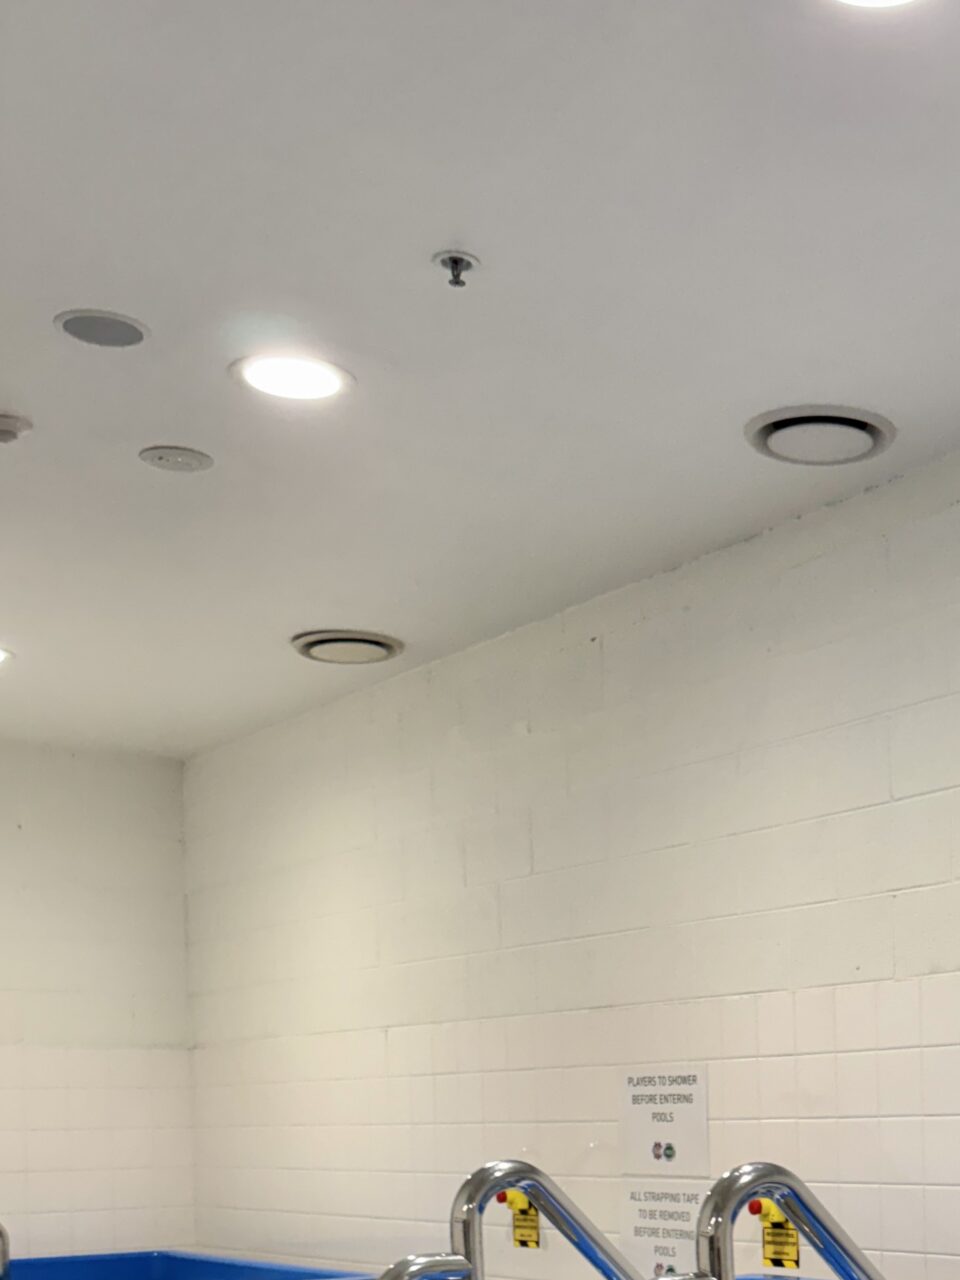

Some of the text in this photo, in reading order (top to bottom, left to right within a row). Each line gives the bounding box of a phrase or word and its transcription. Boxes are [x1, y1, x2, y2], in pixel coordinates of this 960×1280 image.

[627, 1074, 697, 1087] PLAYERS TO SHOWER
[632, 1093, 693, 1105] BEFORE ENTERING
[651, 1111, 674, 1122] POOLS
[630, 1191, 700, 1204] ALL STRAPPING TAPE
[638, 1208, 691, 1222] TO BE REMOVED
[634, 1226, 695, 1240] BEFORE ENTERING
[654, 1245, 676, 1257] POOLS
